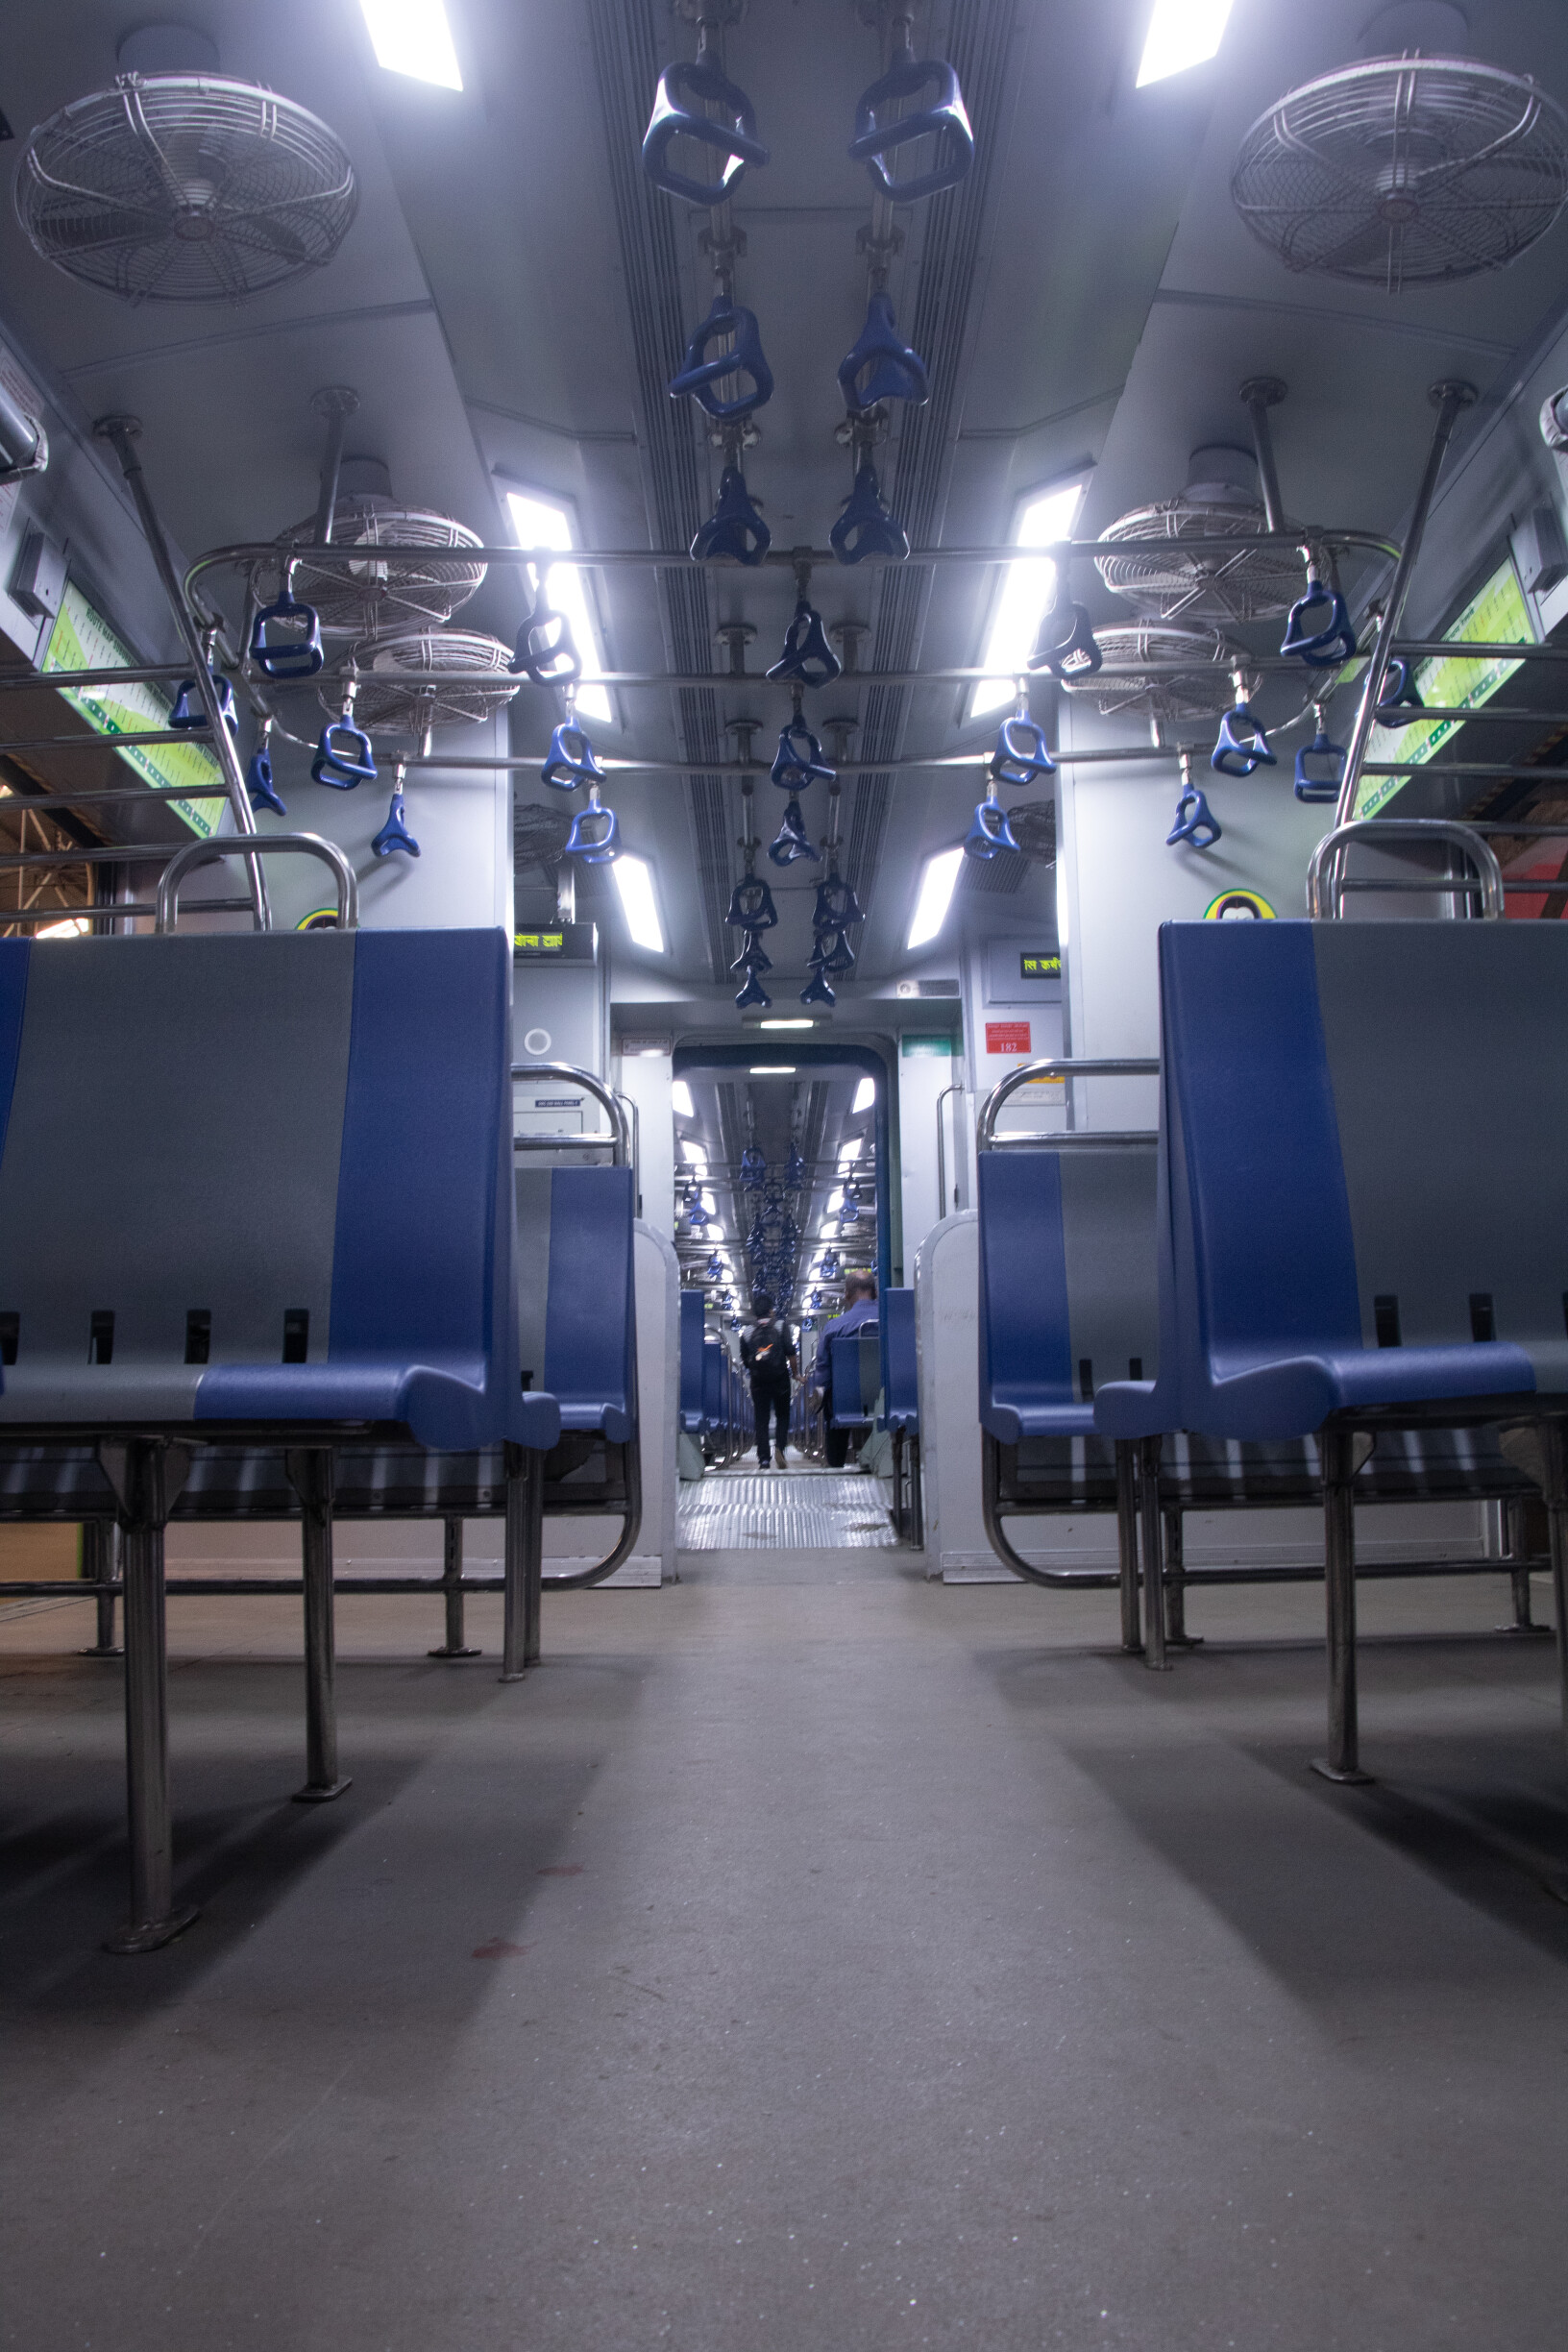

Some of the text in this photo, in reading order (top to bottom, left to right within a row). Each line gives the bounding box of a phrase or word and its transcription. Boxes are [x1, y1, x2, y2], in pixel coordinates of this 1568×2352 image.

[86, 606, 103, 631] ROUTE
[102, 625, 114, 643] MAP
[1000, 1042, 1017, 1053] 182
